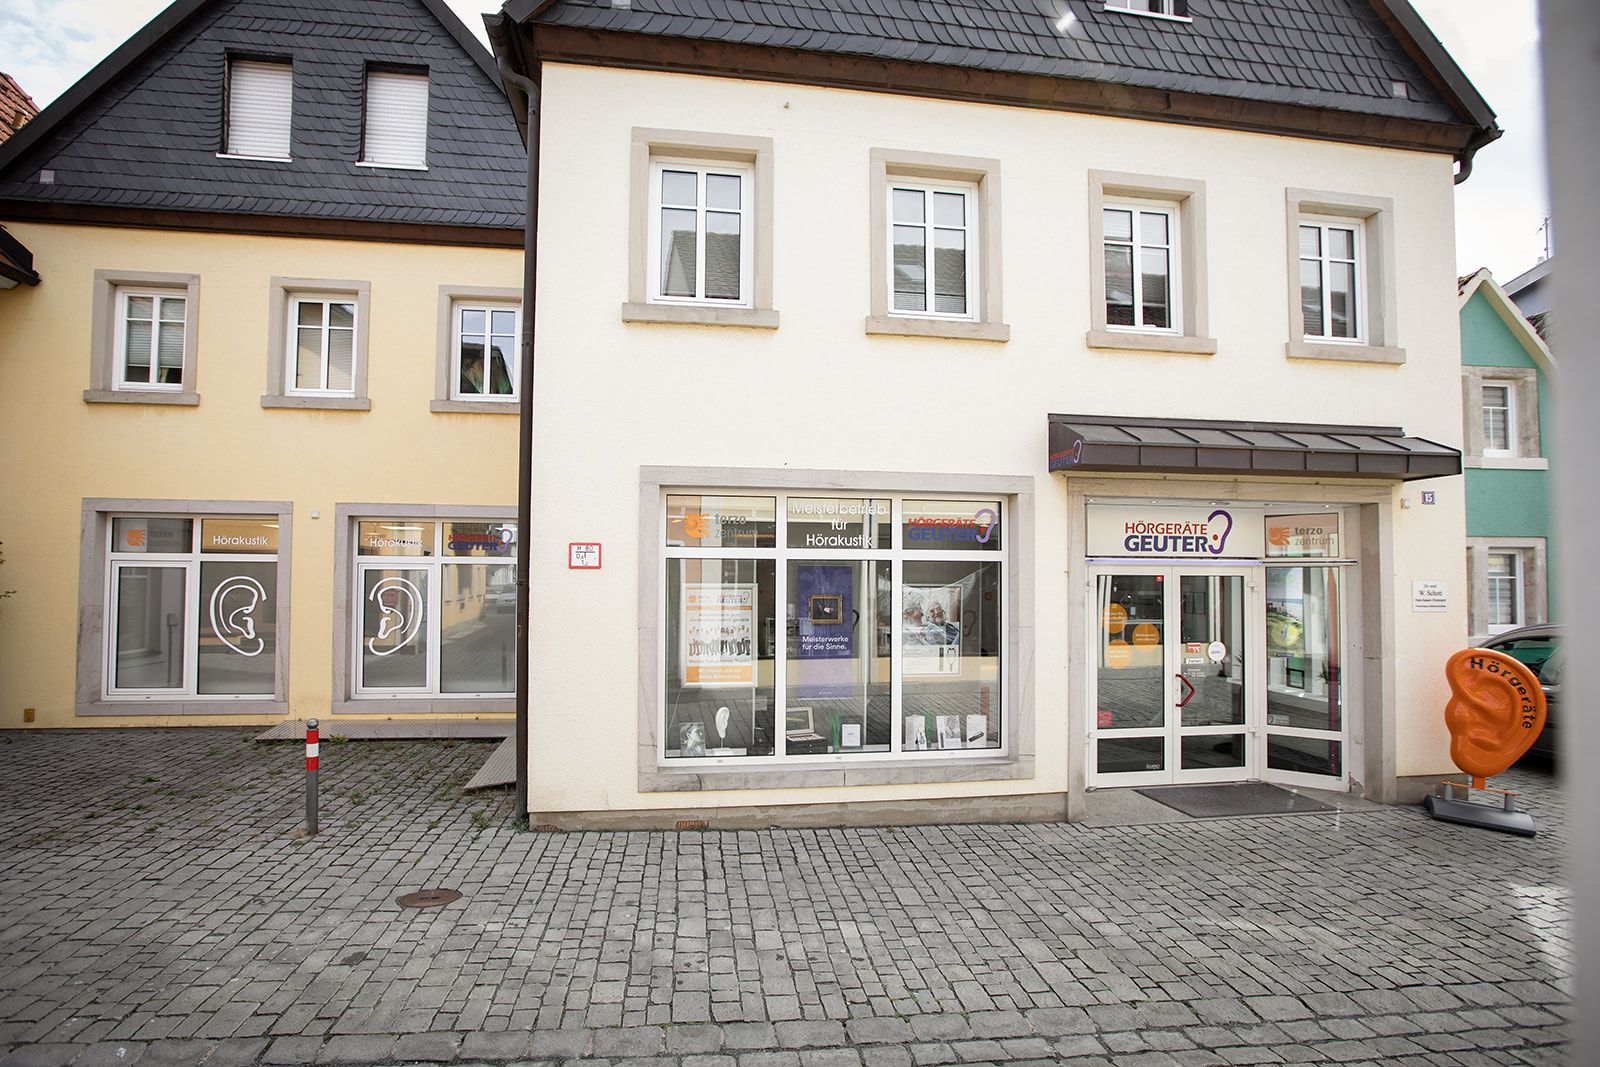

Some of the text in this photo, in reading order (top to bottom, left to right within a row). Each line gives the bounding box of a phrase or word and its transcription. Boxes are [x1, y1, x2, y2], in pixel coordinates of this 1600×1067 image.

[1424, 493, 1433, 503] 15
[792, 503, 886, 515] Meisterbetrieb
[715, 513, 746, 525] terzo
[908, 516, 977, 528] HÖRGERÄTE
[831, 520, 848, 531] für
[1125, 520, 1208, 534] HÖRGERÄTE
[1294, 527, 1323, 535] terzo
[714, 528, 759, 539] zentrum
[908, 527, 977, 541] GEUTER
[213, 535, 268, 545] Hörakustik
[369, 537, 423, 548] Hörakustik
[806, 534, 873, 547] Hörakustik
[1124, 534, 1209, 552] GEUTER
[1294, 536, 1335, 546] zentrum
[802, 635, 849, 643] Meisterwerke
[1470, 657, 1537, 729] Hörgeräte
